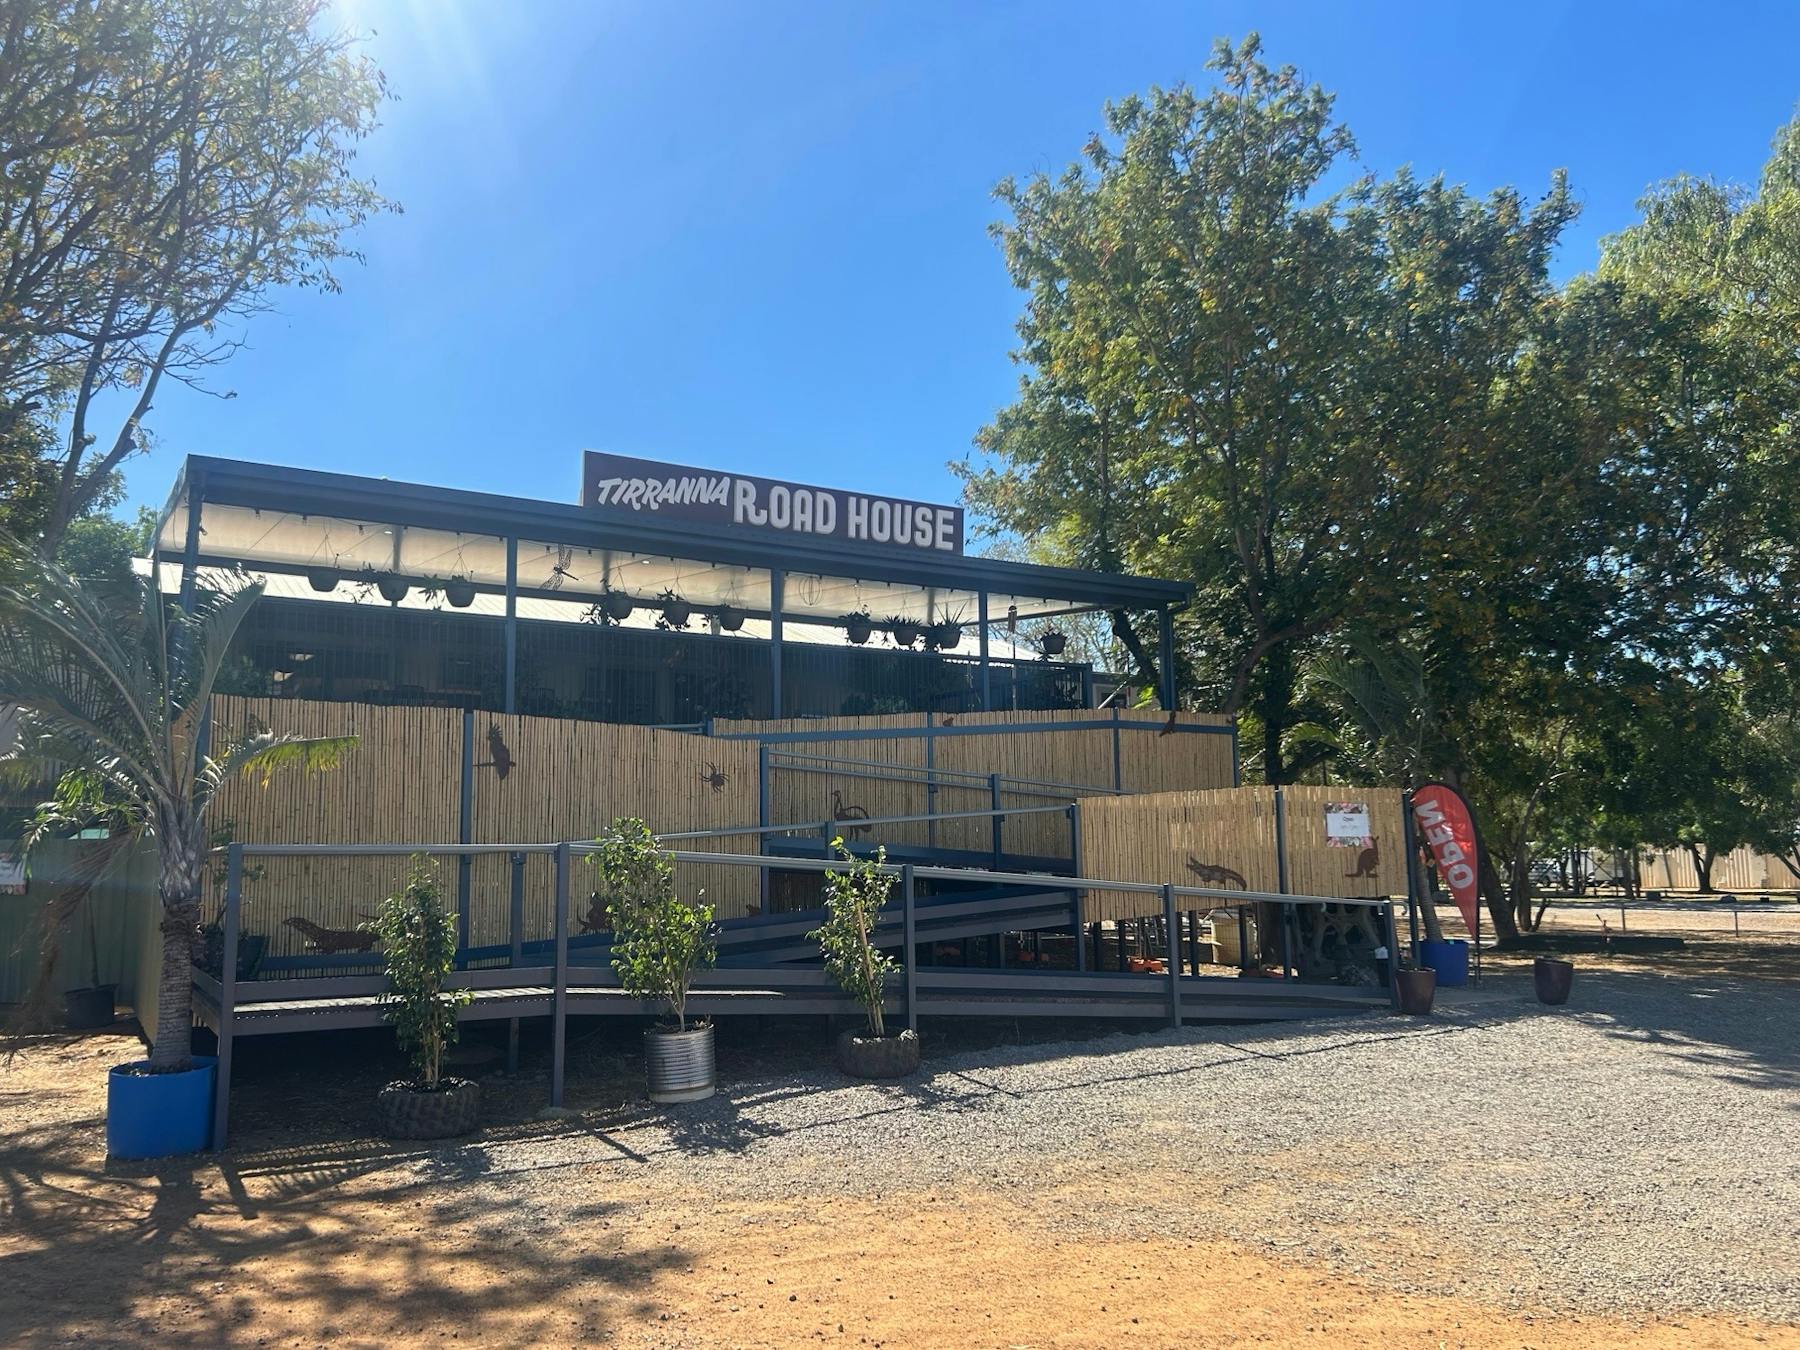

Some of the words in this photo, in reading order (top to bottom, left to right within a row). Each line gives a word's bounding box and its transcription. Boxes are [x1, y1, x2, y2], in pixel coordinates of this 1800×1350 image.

[598, 477, 731, 511] TIRRANNA
[733, 479, 837, 535] ROAD
[848, 496, 954, 551] HOUSE
